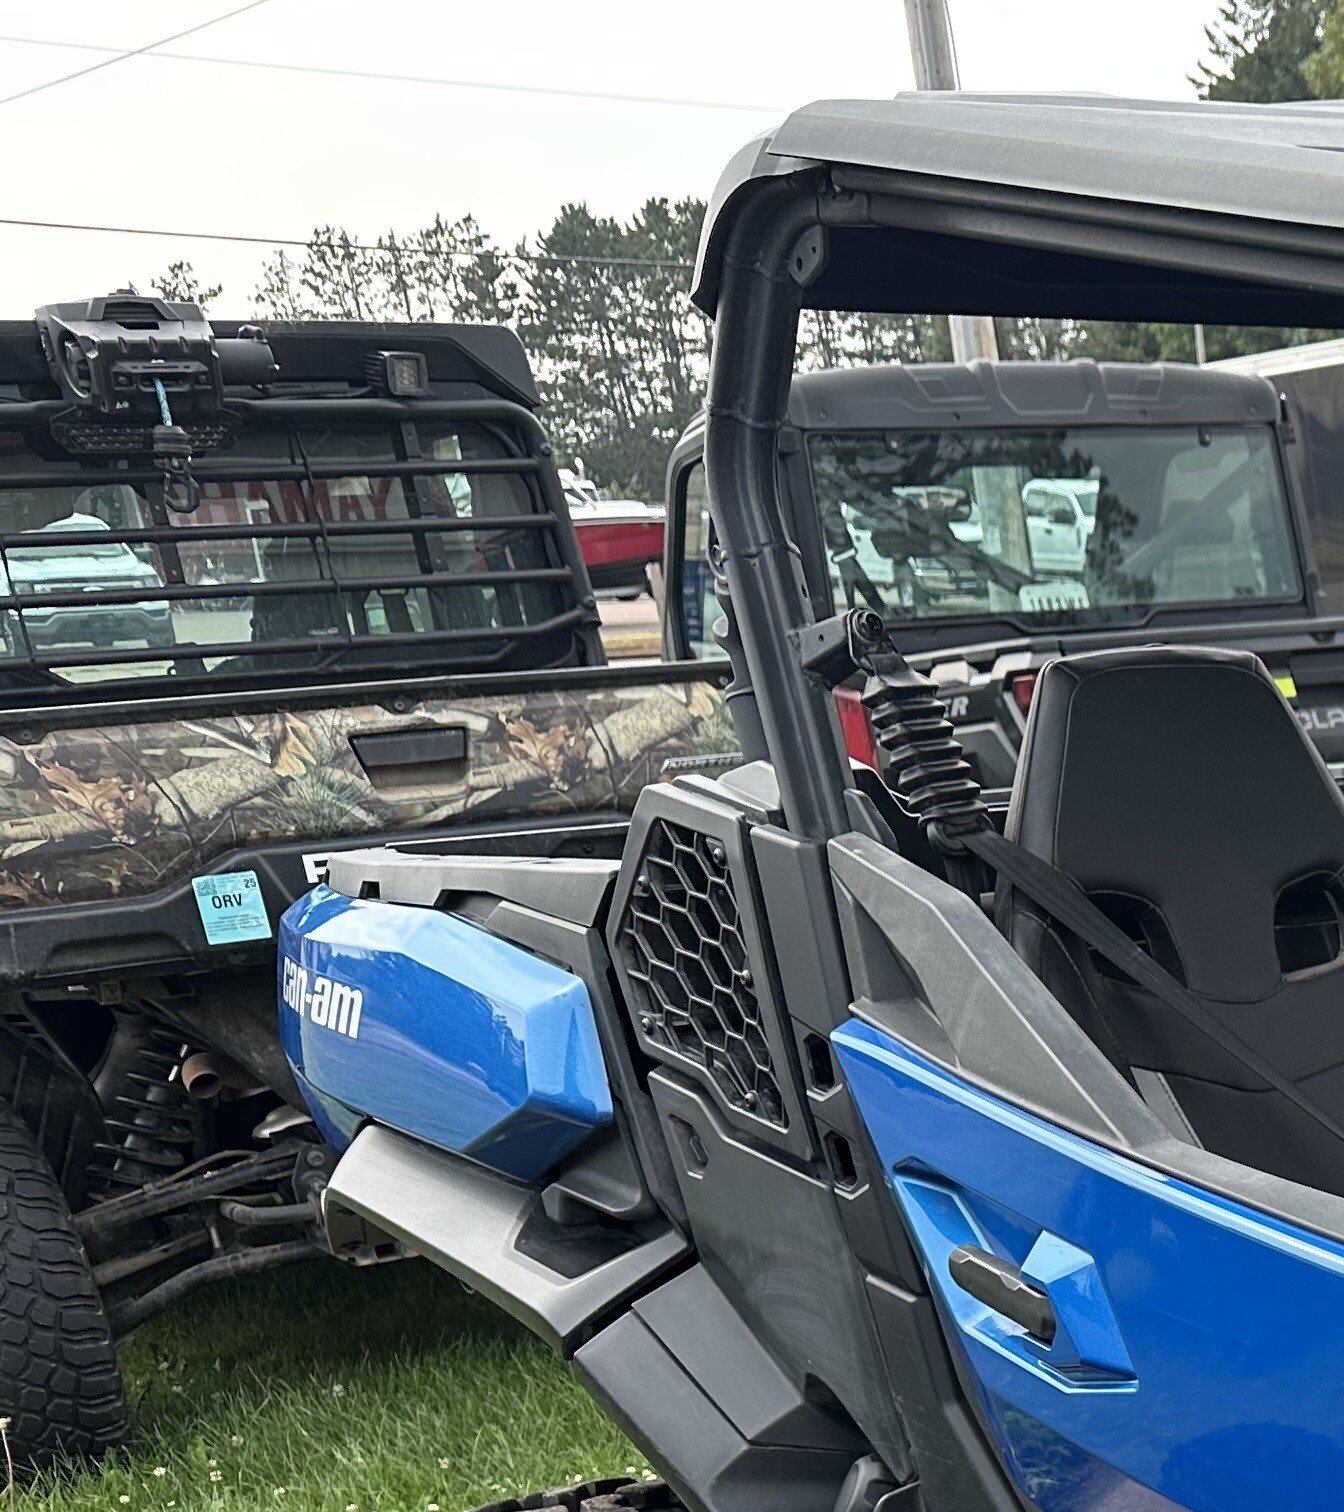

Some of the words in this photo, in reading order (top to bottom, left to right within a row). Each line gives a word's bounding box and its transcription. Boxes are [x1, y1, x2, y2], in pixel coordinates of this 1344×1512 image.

[243, 877, 257, 889] 25
[211, 893, 243, 909] ORV
[283, 956, 363, 1039] can-am
